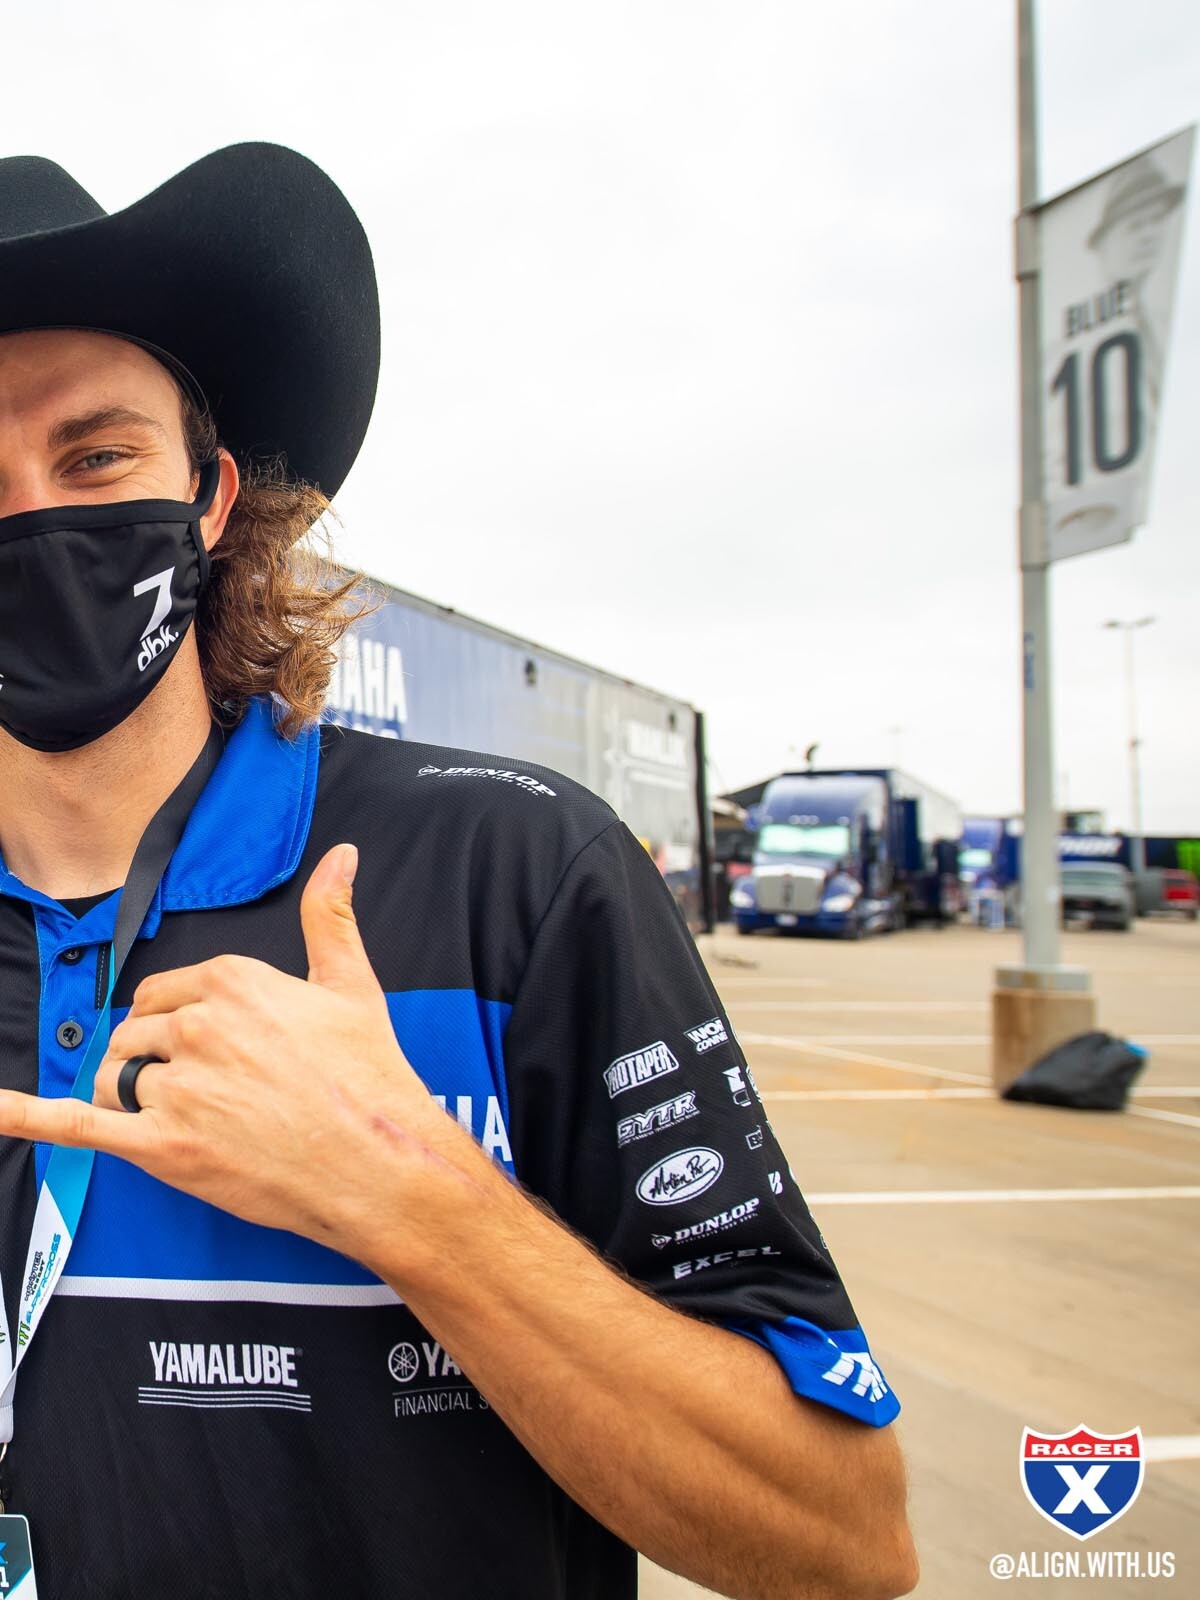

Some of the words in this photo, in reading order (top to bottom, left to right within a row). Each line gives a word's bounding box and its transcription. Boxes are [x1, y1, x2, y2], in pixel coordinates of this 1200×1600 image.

[1066, 280, 1131, 336] BLUE
[1051, 332, 1141, 485] 10
[133, 566, 175, 641] 7
[441, 767, 557, 797] DUNLOP
[617, 1093, 697, 1146] GYTR
[674, 1197, 760, 1241] DUNLOP
[674, 1246, 781, 1280] EXCEL
[149, 1341, 298, 1387] YAMALUBE
[394, 1392, 472, 1418] FINANCIAL
